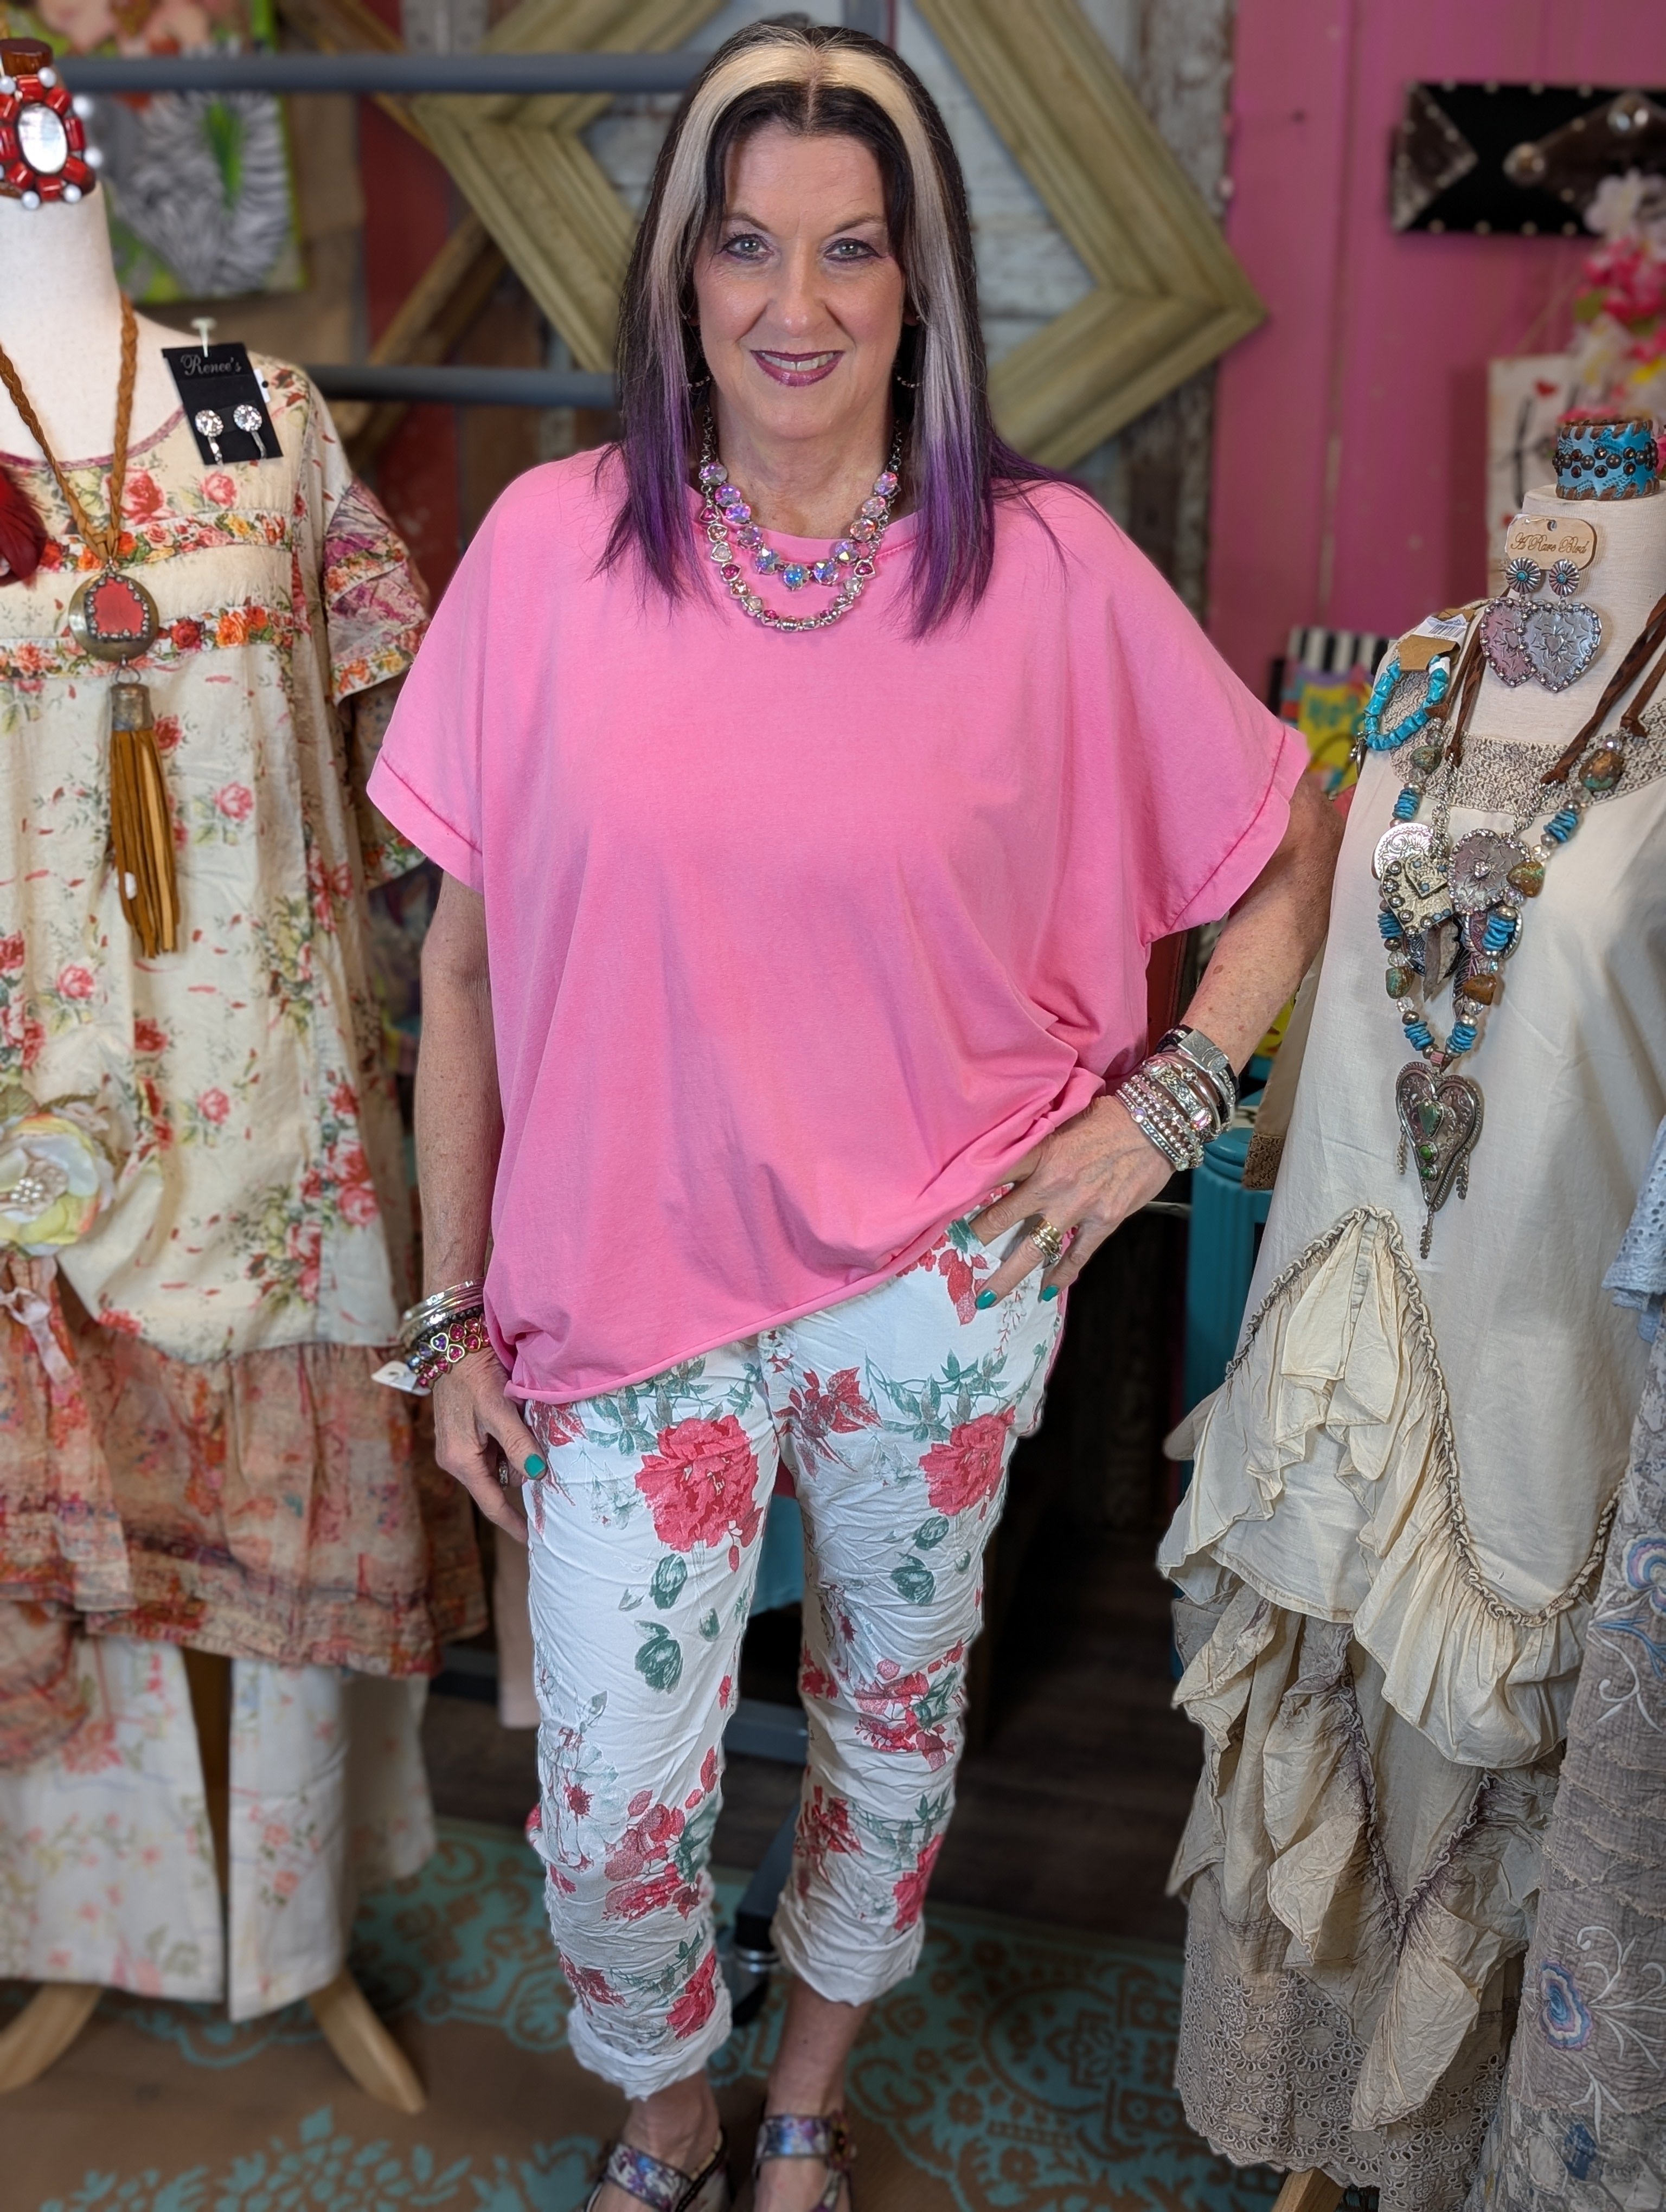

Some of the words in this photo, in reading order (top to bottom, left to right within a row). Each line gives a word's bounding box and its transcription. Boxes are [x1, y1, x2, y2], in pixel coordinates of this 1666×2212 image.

[180, 354, 242, 376] Renee's
[1510, 532, 1528, 550] A
[1527, 534, 1556, 552] Rare
[1558, 536, 1590, 554] Bird
